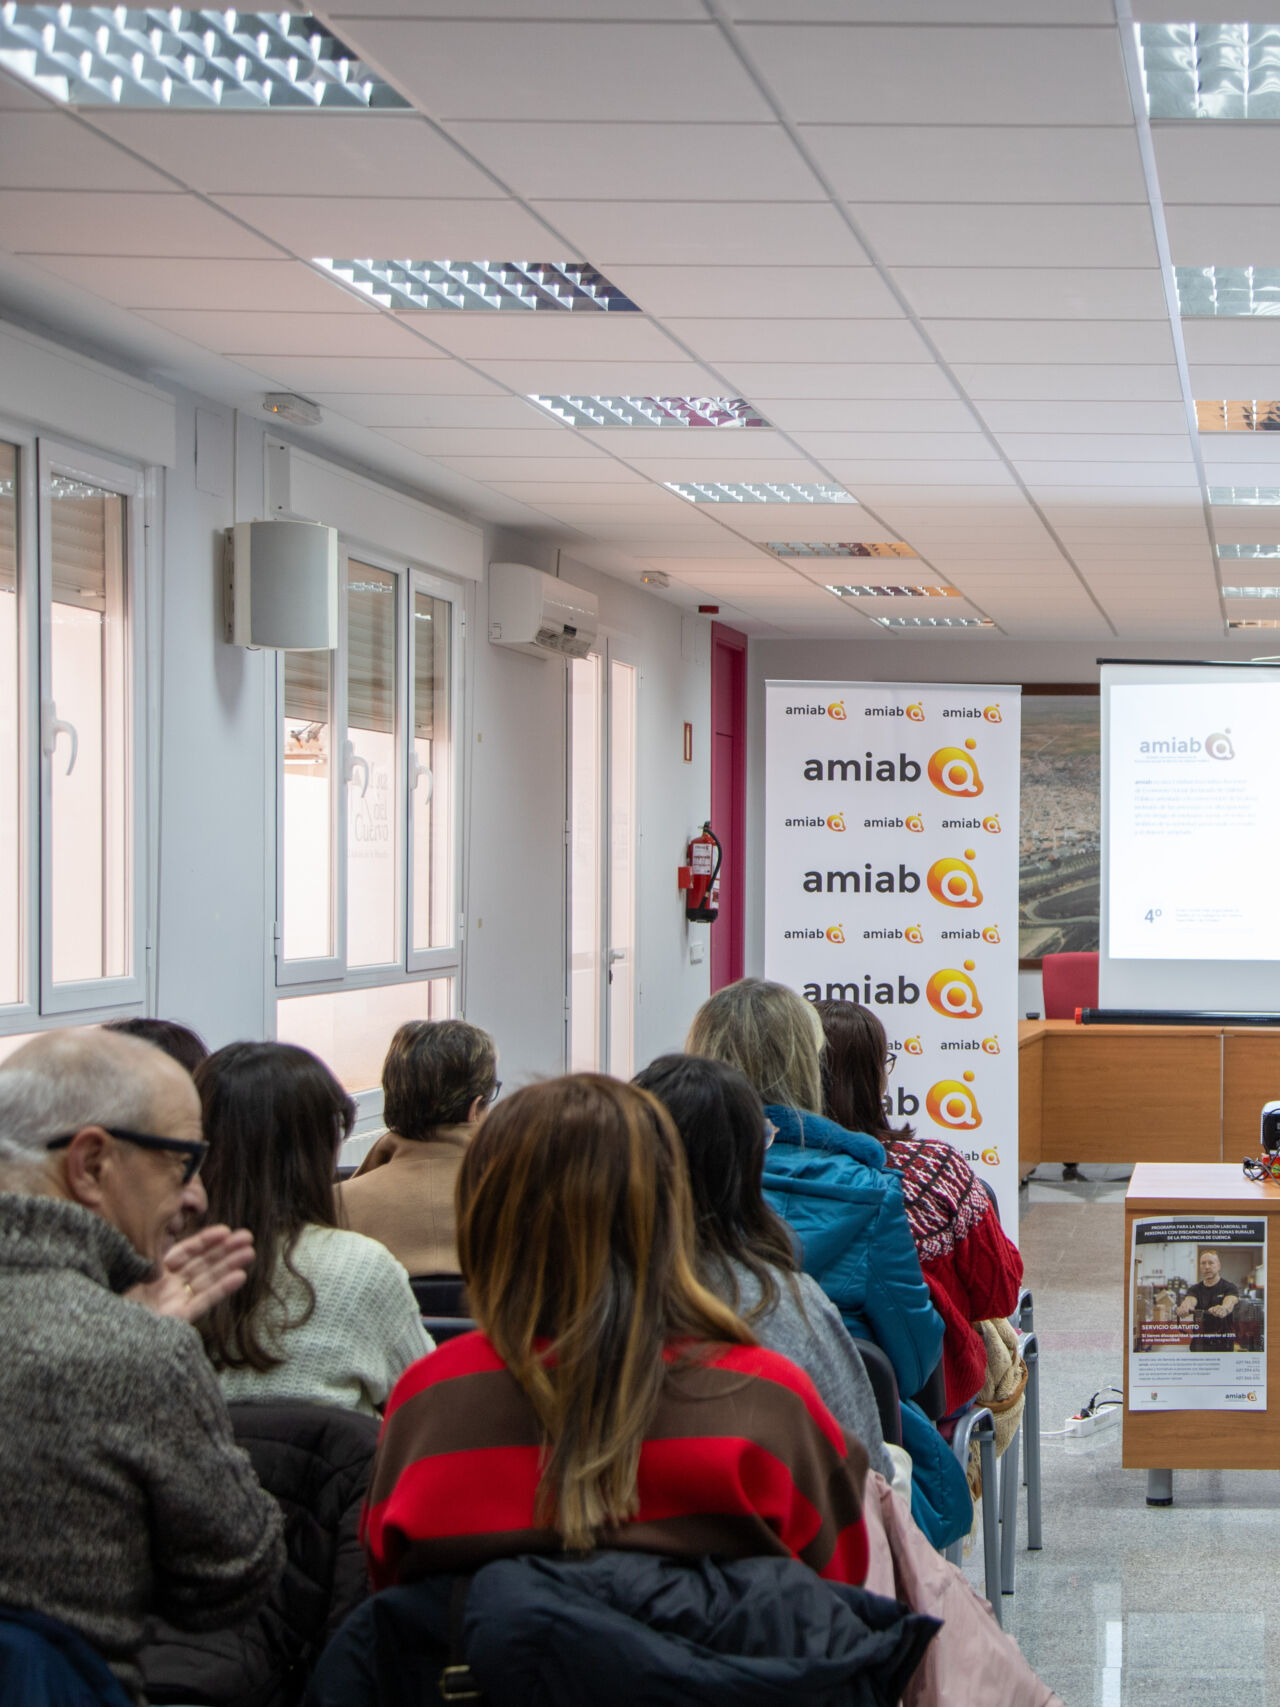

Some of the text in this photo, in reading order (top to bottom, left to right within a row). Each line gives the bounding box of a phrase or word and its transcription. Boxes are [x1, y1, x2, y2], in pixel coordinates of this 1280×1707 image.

[785, 704, 826, 716] amiab
[864, 705, 904, 717] amiab
[942, 707, 982, 718] amiab
[1139, 736, 1202, 754] amiab
[803, 751, 922, 782] amiab
[785, 816, 826, 828] amiab
[863, 816, 904, 828] amiab
[941, 818, 981, 829] amiab
[802, 862, 921, 893] amiab
[784, 927, 825, 939] amiab
[863, 928, 903, 939] amiab
[940, 928, 981, 940] amiab
[803, 974, 920, 1005] amiab
[940, 1040, 980, 1051] amiab
[1225, 1392, 1247, 1400] amiab
